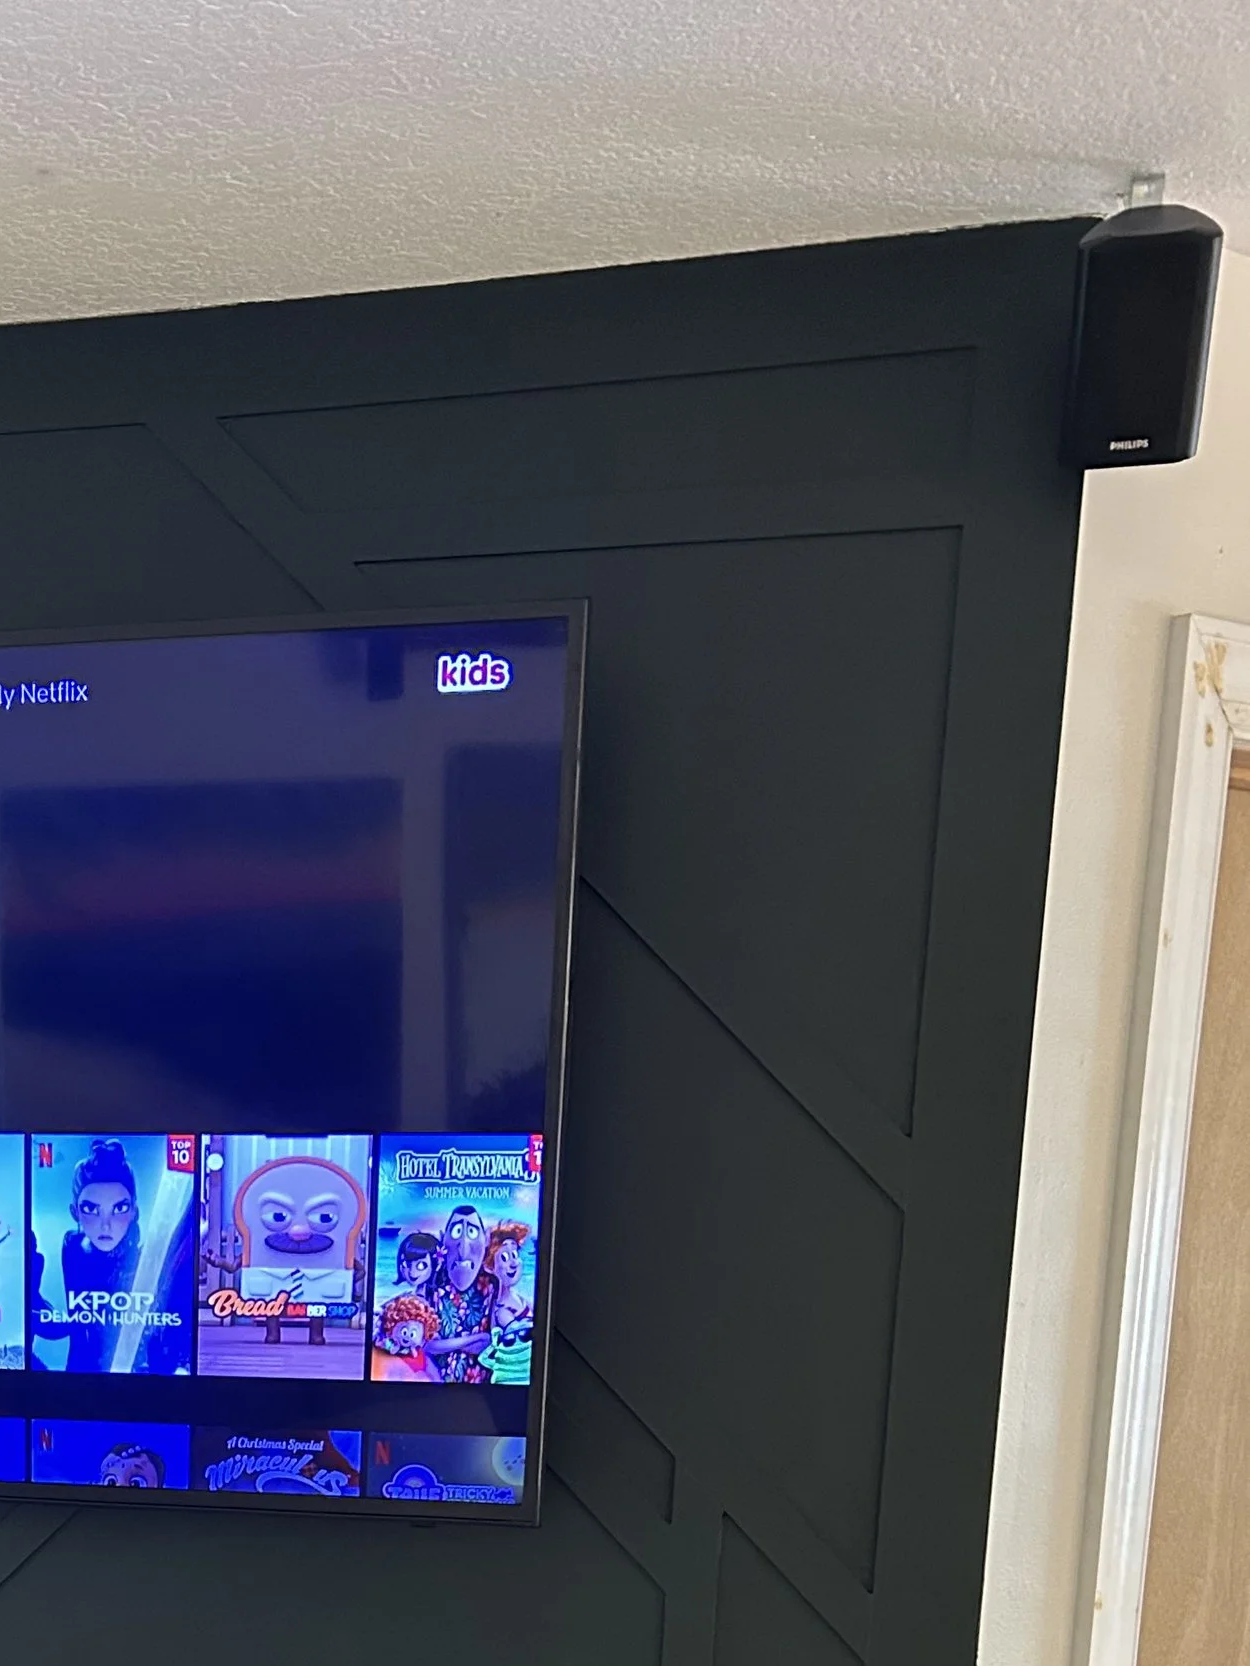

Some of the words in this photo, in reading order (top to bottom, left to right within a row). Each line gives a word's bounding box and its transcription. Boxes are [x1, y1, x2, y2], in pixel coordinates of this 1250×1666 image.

[1110, 439, 1149, 451] PHILIPS
[437, 653, 510, 693] kids
[20, 679, 89, 706] Netflix
[39, 1142, 53, 1168] N
[171, 1140, 192, 1150] TOP
[172, 1150, 191, 1165] 10
[401, 1154, 442, 1179] HOTEL
[442, 1152, 524, 1180] TRANSYLVANIA
[424, 1186, 465, 1199] SUMMER
[466, 1186, 510, 1199] VACATION
[208, 1289, 291, 1317] Bread
[40, 1308, 106, 1326] DEMON
[113, 1310, 182, 1327] HUNTERS
[238, 1436, 287, 1450] Christmas
[287, 1438, 325, 1453] Special
[375, 1440, 390, 1465] N
